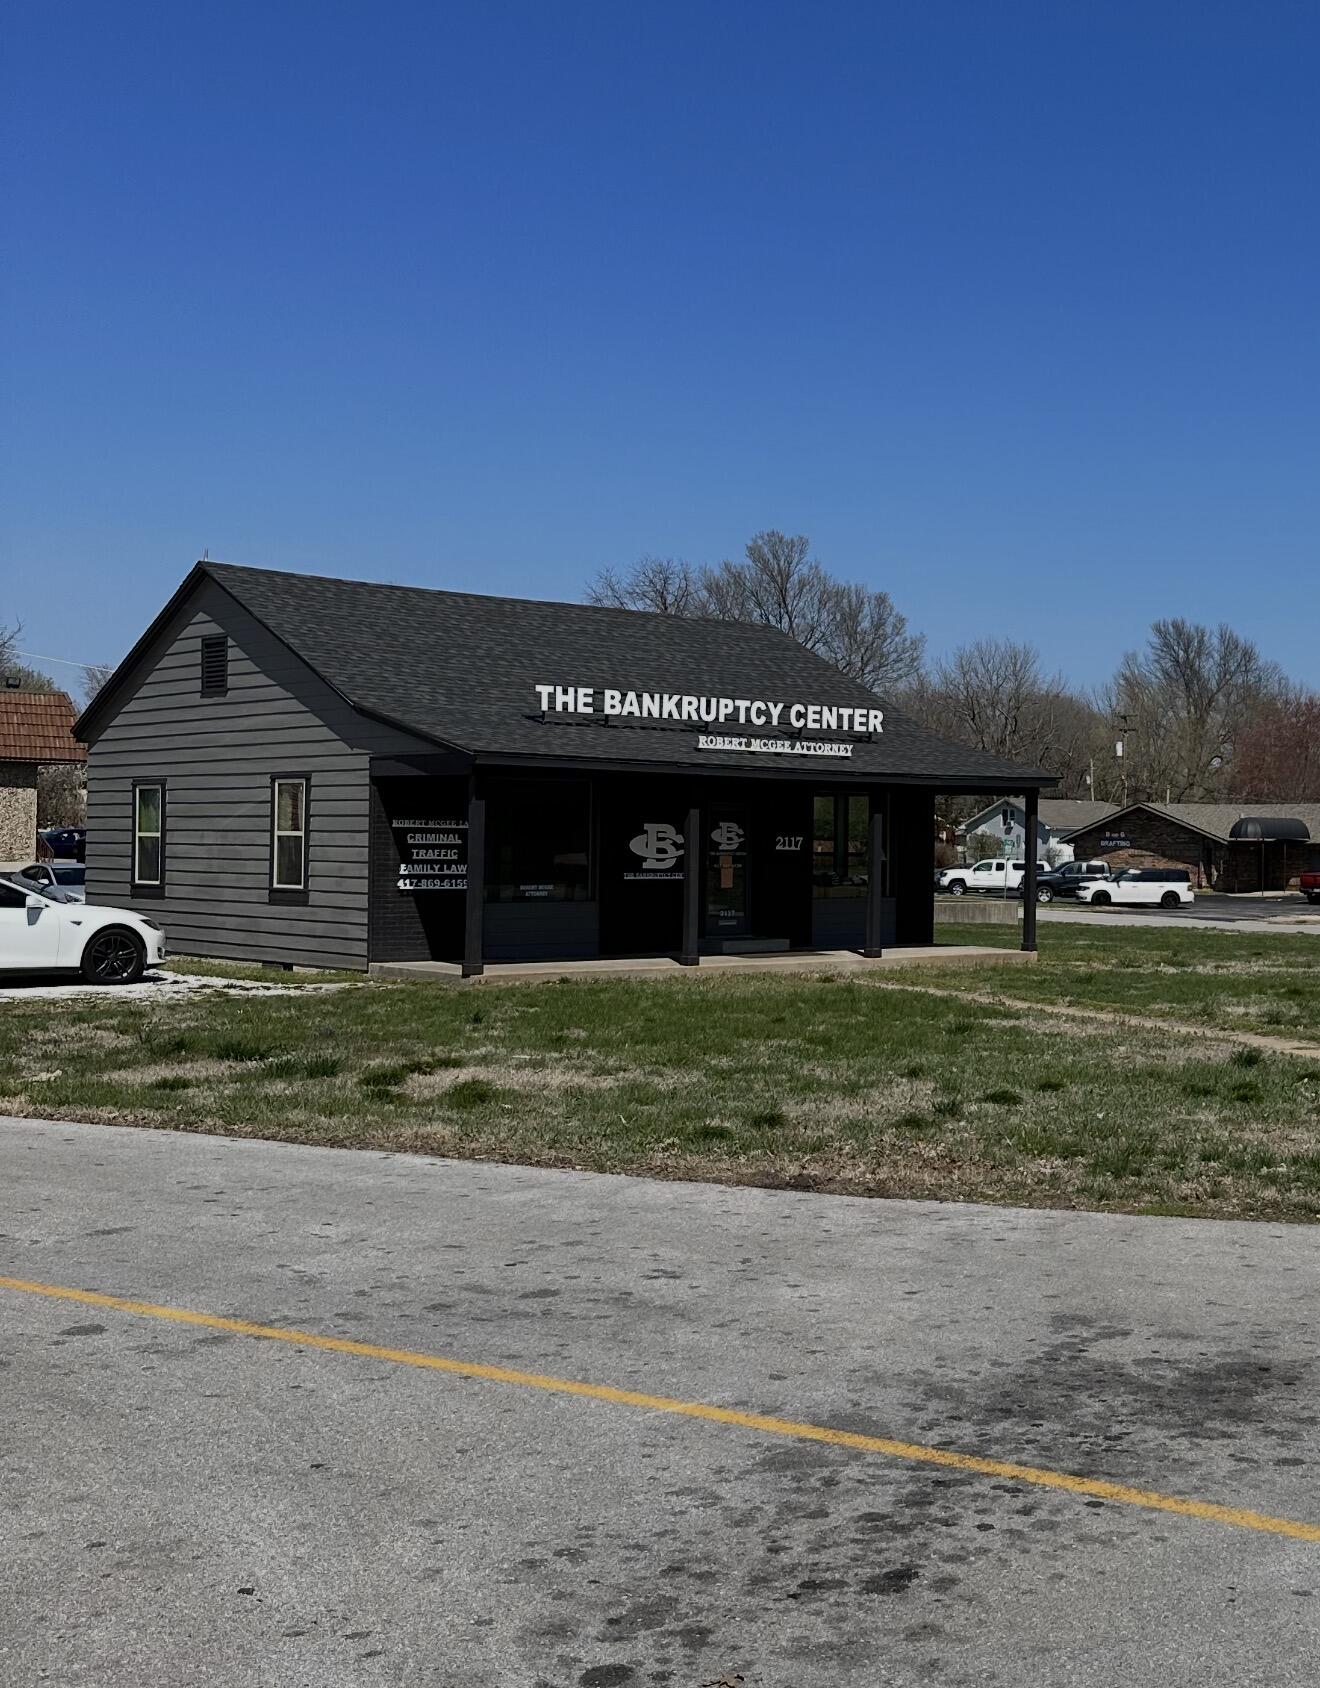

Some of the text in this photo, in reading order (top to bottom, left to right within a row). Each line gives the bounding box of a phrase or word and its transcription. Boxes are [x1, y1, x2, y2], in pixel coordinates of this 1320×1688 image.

[535, 684, 884, 733] THE BANKRUPTCY CENTER
[697, 735, 853, 757] ROBERT MCGEE ATTORNEY
[392, 819, 427, 828] ROBERT
[428, 820, 457, 828] MCGEE
[407, 833, 462, 844] CRIMINAL
[775, 836, 804, 851] 2117
[411, 849, 459, 860] TRAFFIC
[399, 863, 468, 875] FAMILY LAW
